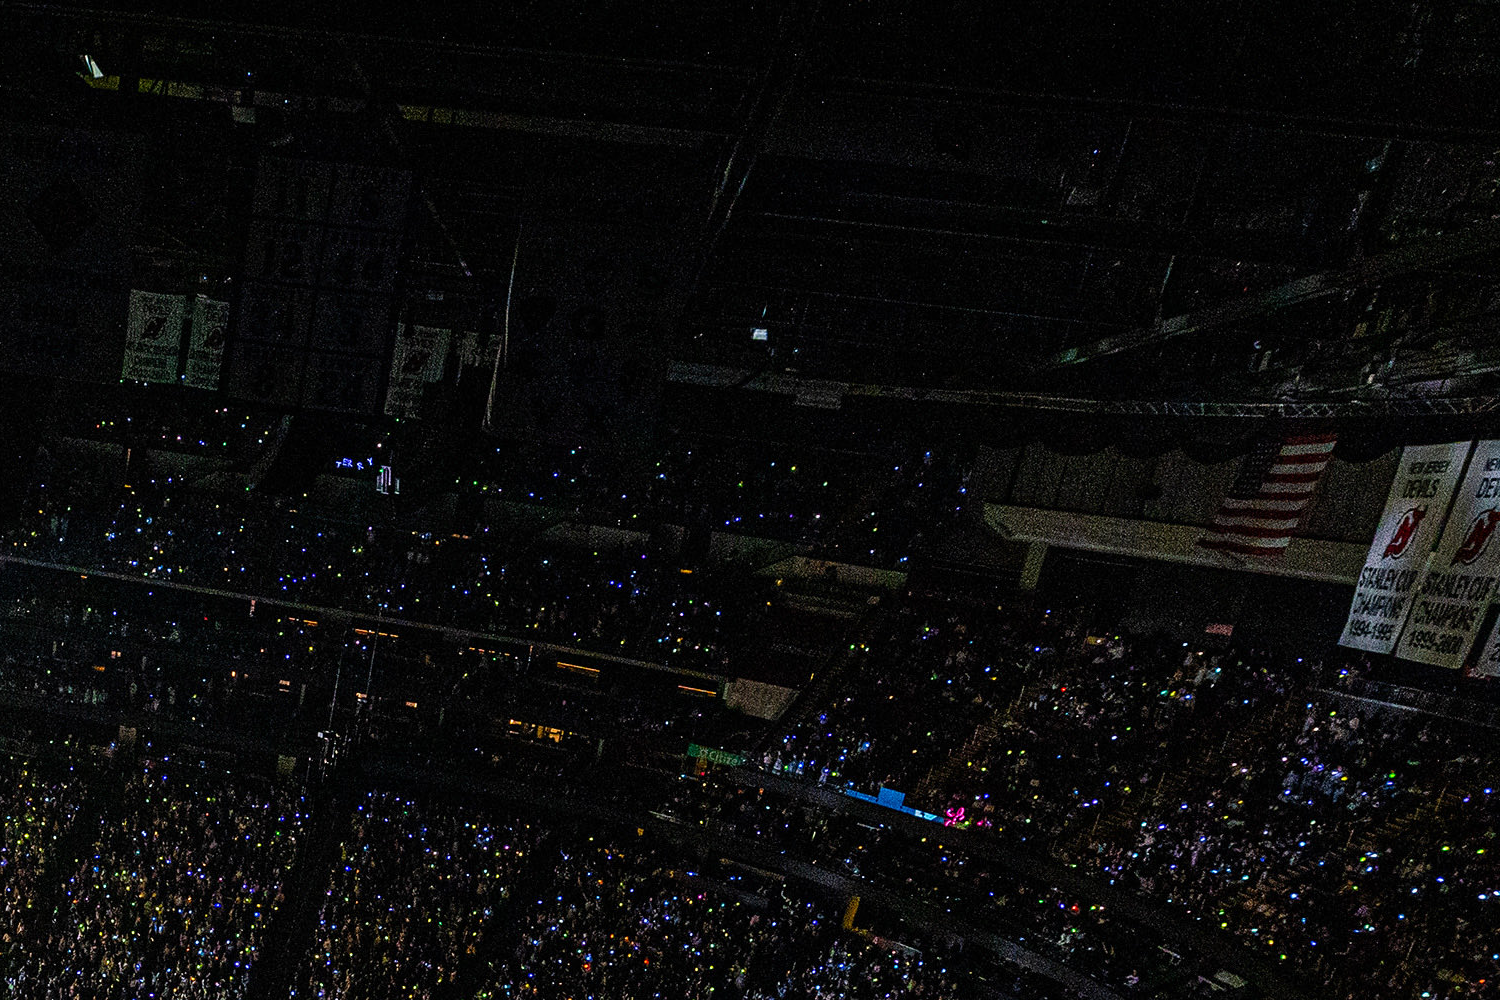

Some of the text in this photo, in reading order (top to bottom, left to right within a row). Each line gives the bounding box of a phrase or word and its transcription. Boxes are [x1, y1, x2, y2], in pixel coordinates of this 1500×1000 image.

[1409, 460, 1451, 474] NEW JERSEY
[1402, 478, 1440, 498] DEVILS
[1476, 478, 1500, 498] DEV
[1360, 567, 1417, 592] STANLEY CUP
[1422, 572, 1495, 601] STANLEY CUP
[1353, 593, 1406, 619] CHAMPIONS
[1415, 601, 1479, 631] CHAMPIONS
[1350, 620, 1395, 640] 1994-1995
[1408, 630, 1463, 654] 1999-2000
